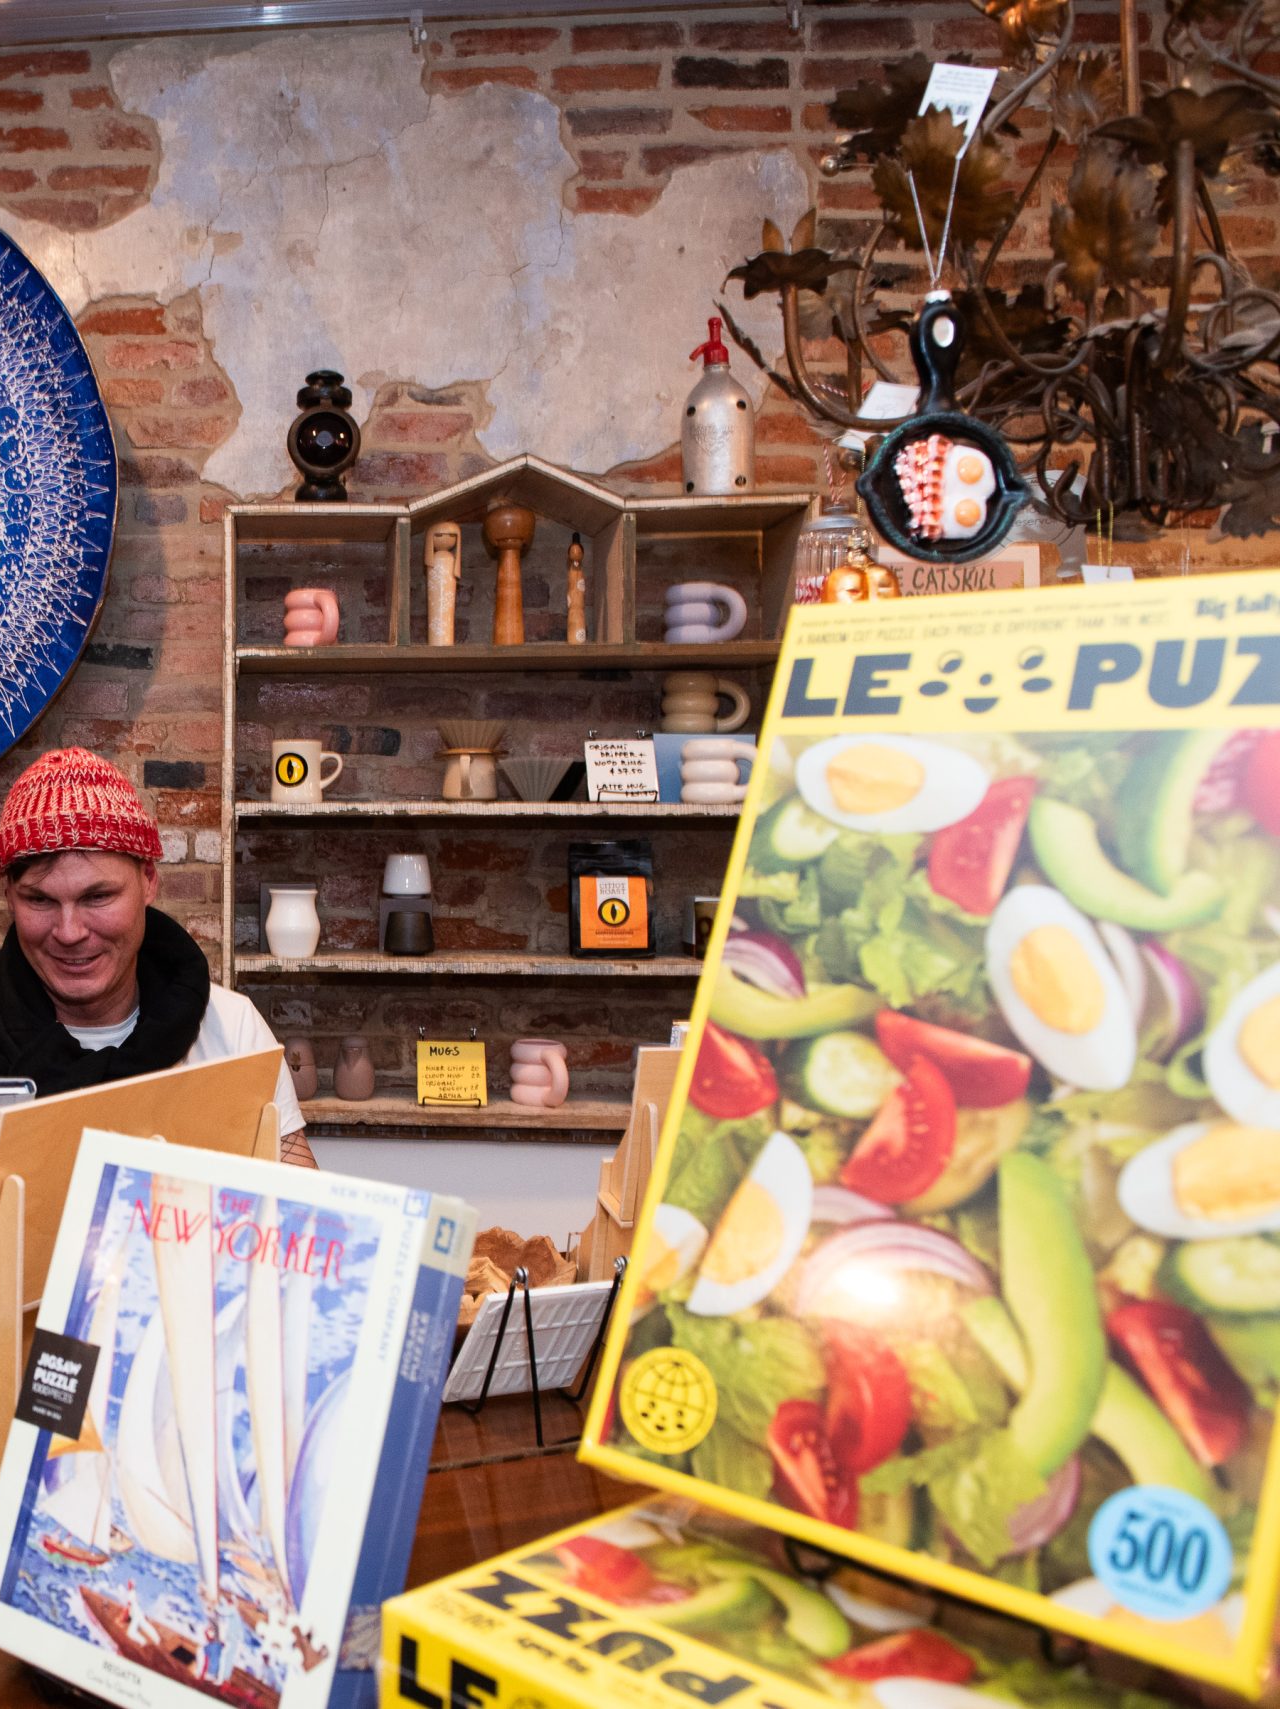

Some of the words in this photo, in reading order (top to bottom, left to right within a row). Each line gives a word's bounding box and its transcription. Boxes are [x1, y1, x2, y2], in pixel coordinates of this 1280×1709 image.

[912, 566, 996, 592] CATSKILL
[781, 653, 912, 717] LE
[429, 1046, 460, 1056] MUGS
[219, 1192, 254, 1214] THE
[128, 1199, 209, 1245] NEW
[215, 1215, 345, 1283] YORKER
[37, 1352, 82, 1376] JIGSAW
[34, 1366, 78, 1393] PUZZLE
[1108, 1510, 1210, 1595] 500
[399, 1634, 498, 1709] LE
